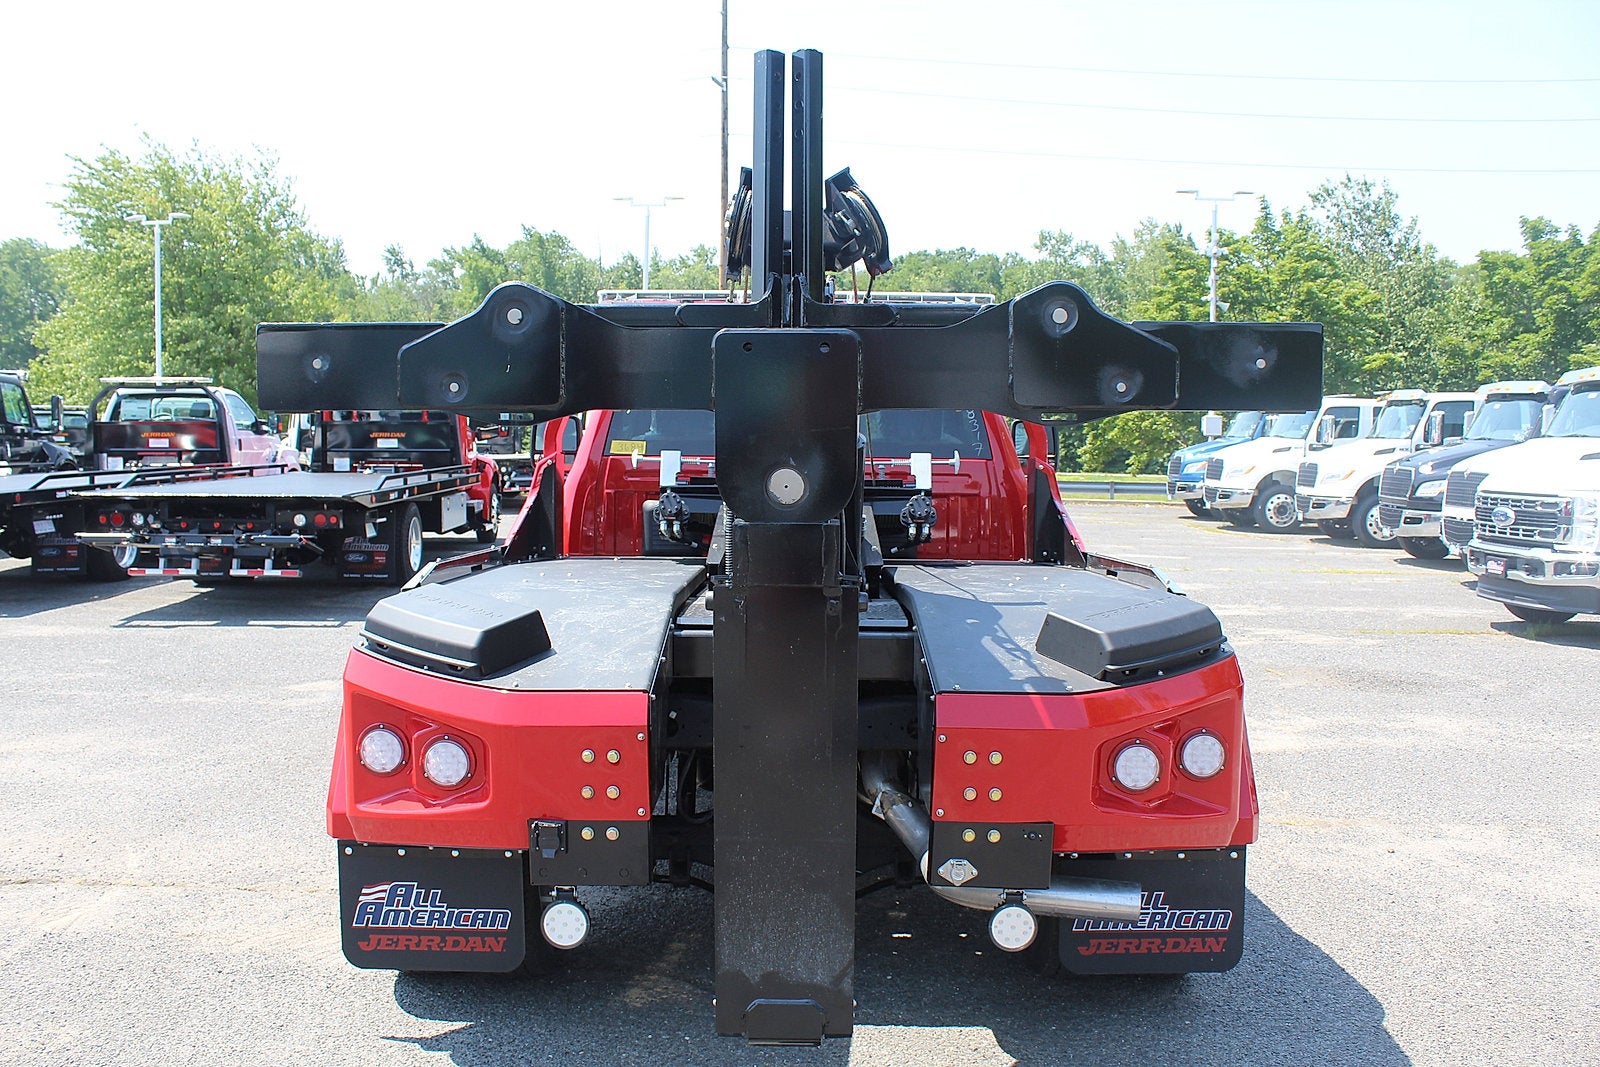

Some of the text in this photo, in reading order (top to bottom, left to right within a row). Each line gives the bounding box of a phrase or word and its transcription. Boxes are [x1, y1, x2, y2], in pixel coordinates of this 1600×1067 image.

[1141, 891, 1170, 911] LL
[358, 934, 507, 952] JERR-DAN
[1077, 937, 1228, 956] JERR-DAN
